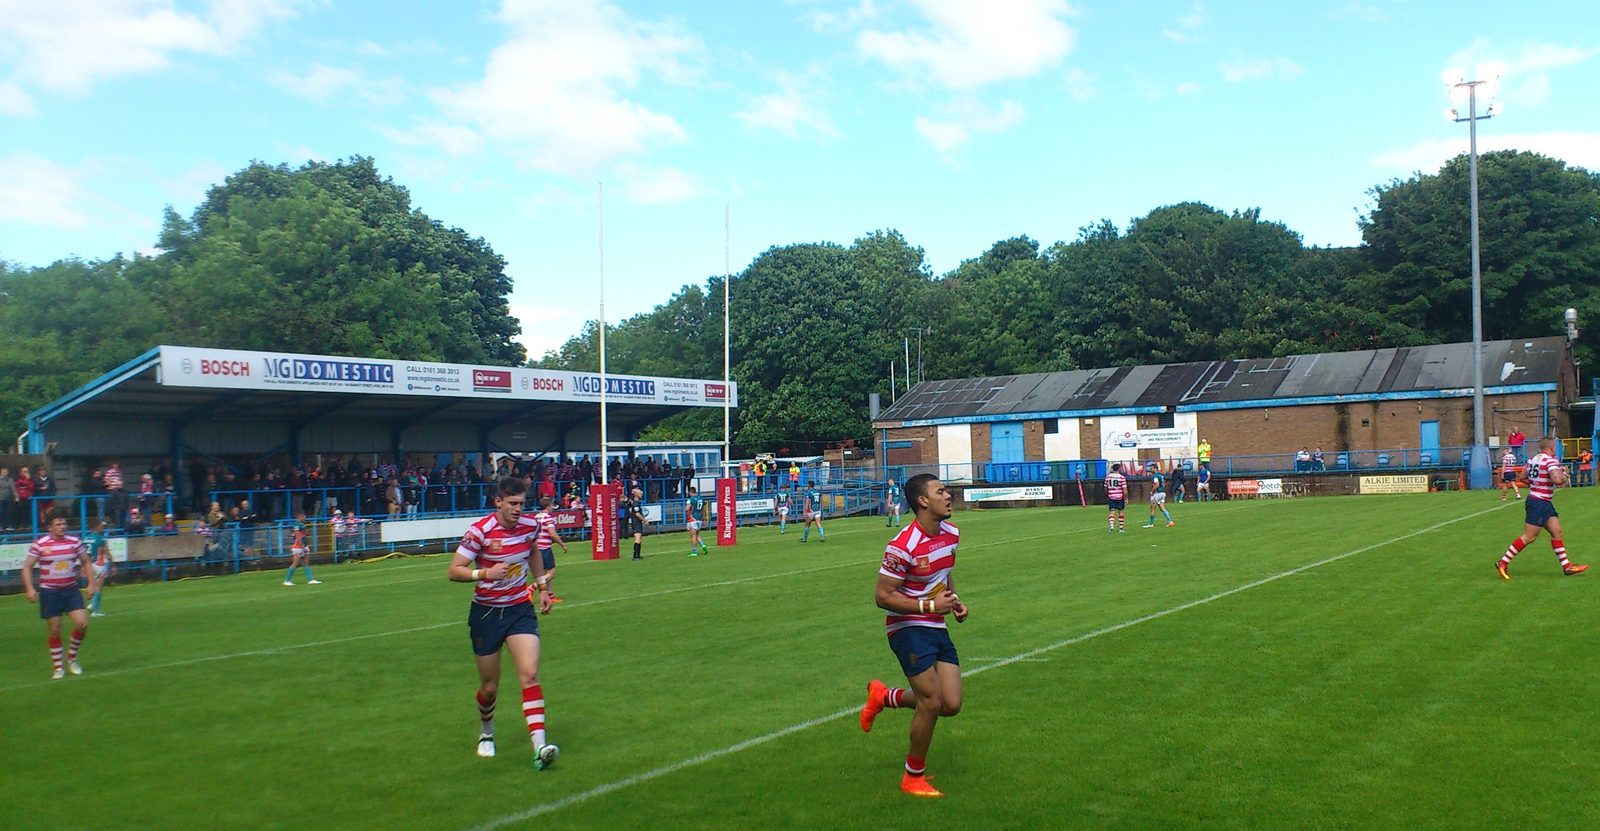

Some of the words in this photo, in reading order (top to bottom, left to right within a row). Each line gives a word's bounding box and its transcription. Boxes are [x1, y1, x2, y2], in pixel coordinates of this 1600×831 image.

[201, 359, 250, 376] BOSCH
[533, 378, 564, 391] BOSCH
[1528, 464, 1540, 478] 26
[1108, 480, 1119, 488] 18
[596, 494, 604, 514] Press
[558, 514, 576, 524] Cider
[724, 505, 732, 538] Kingstone
[596, 516, 605, 552] Kingstone
